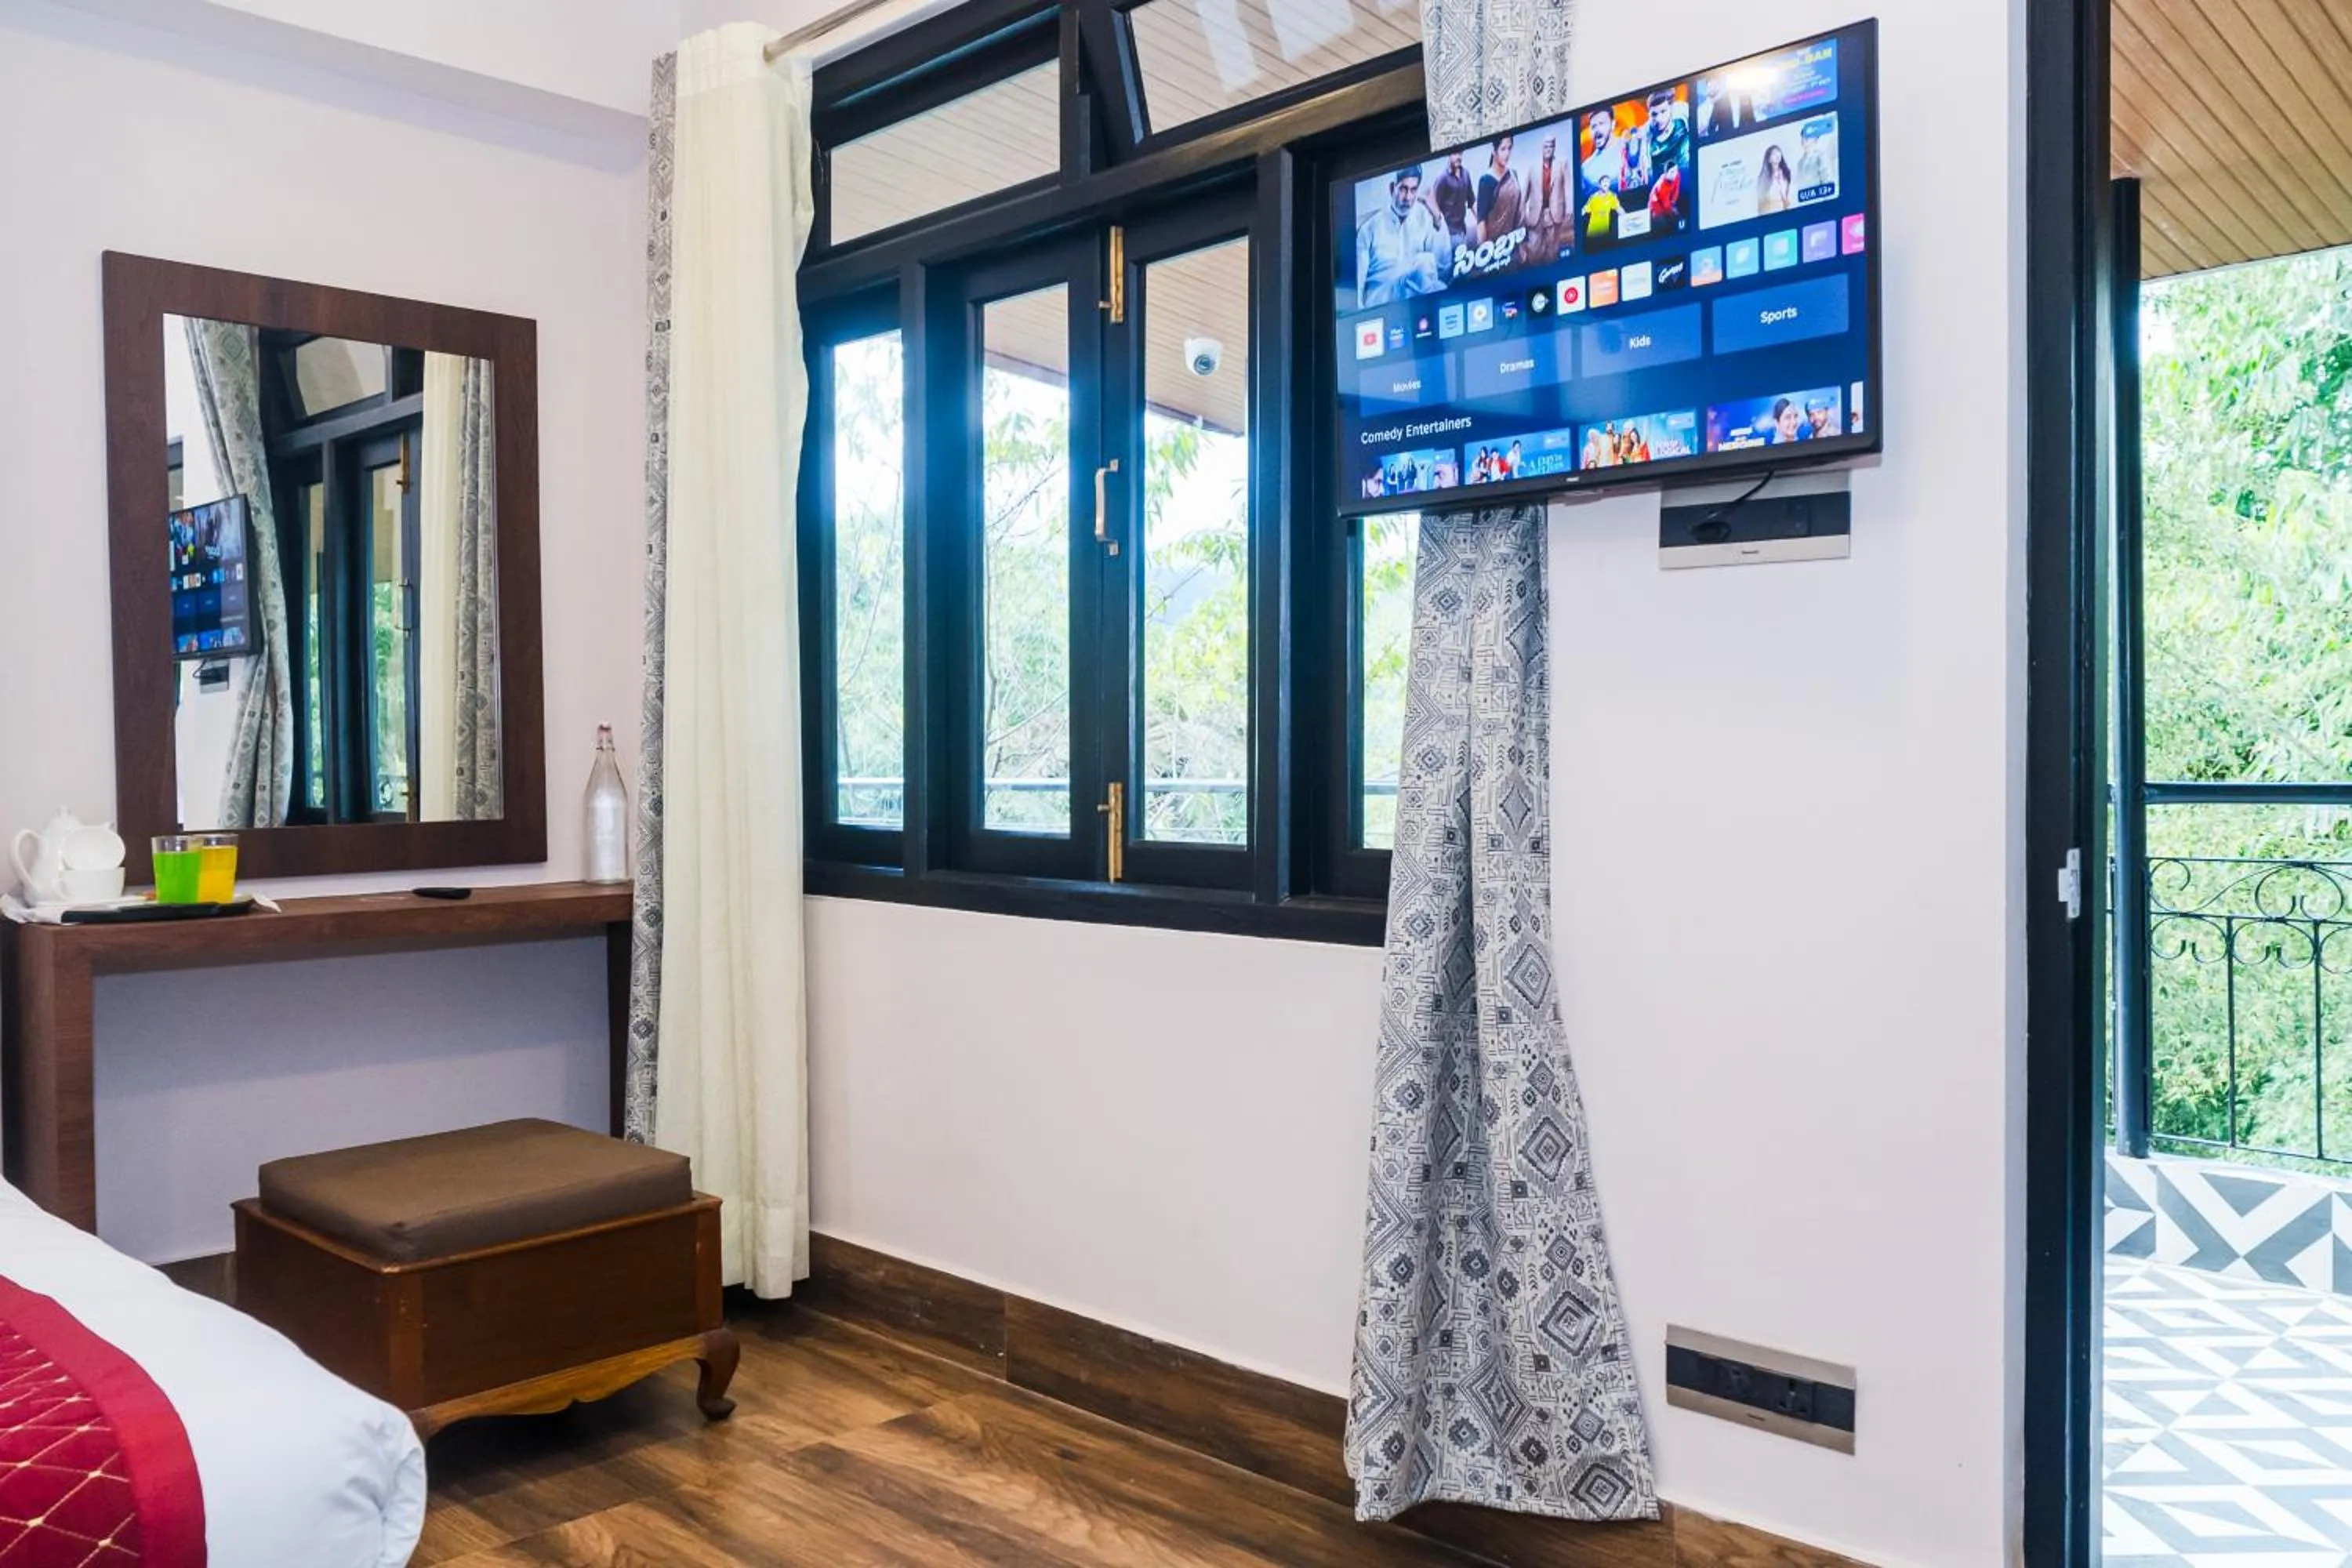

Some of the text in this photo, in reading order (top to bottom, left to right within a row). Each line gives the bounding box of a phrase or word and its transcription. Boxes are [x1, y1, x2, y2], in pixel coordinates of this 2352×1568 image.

[1759, 307, 1798, 325] Sports
[1629, 335, 1651, 350] Kids
[1500, 358, 1534, 374] Dramas
[1393, 379, 1421, 394] Movies
[1360, 416, 1472, 445] Comedy Entertainers
